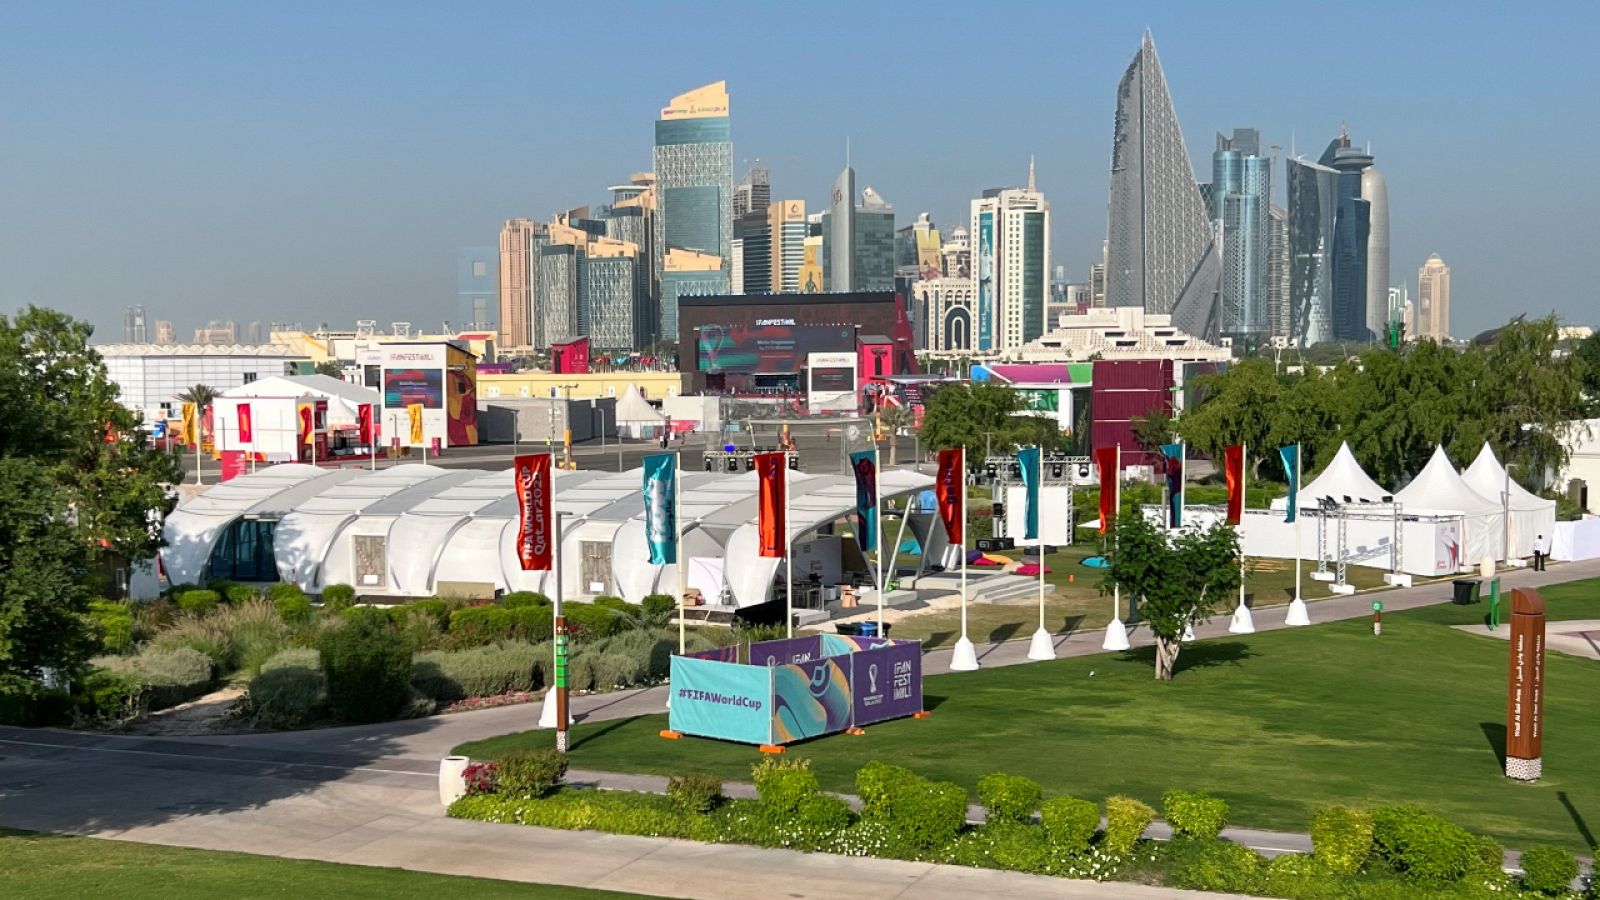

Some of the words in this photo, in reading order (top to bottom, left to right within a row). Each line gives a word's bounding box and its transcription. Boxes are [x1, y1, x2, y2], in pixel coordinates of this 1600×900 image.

[522, 465, 532, 490] CUP
[523, 490, 534, 534] WORLD
[522, 534, 534, 560] FIFA
[678, 688, 763, 712] #FIFAWorldCup
